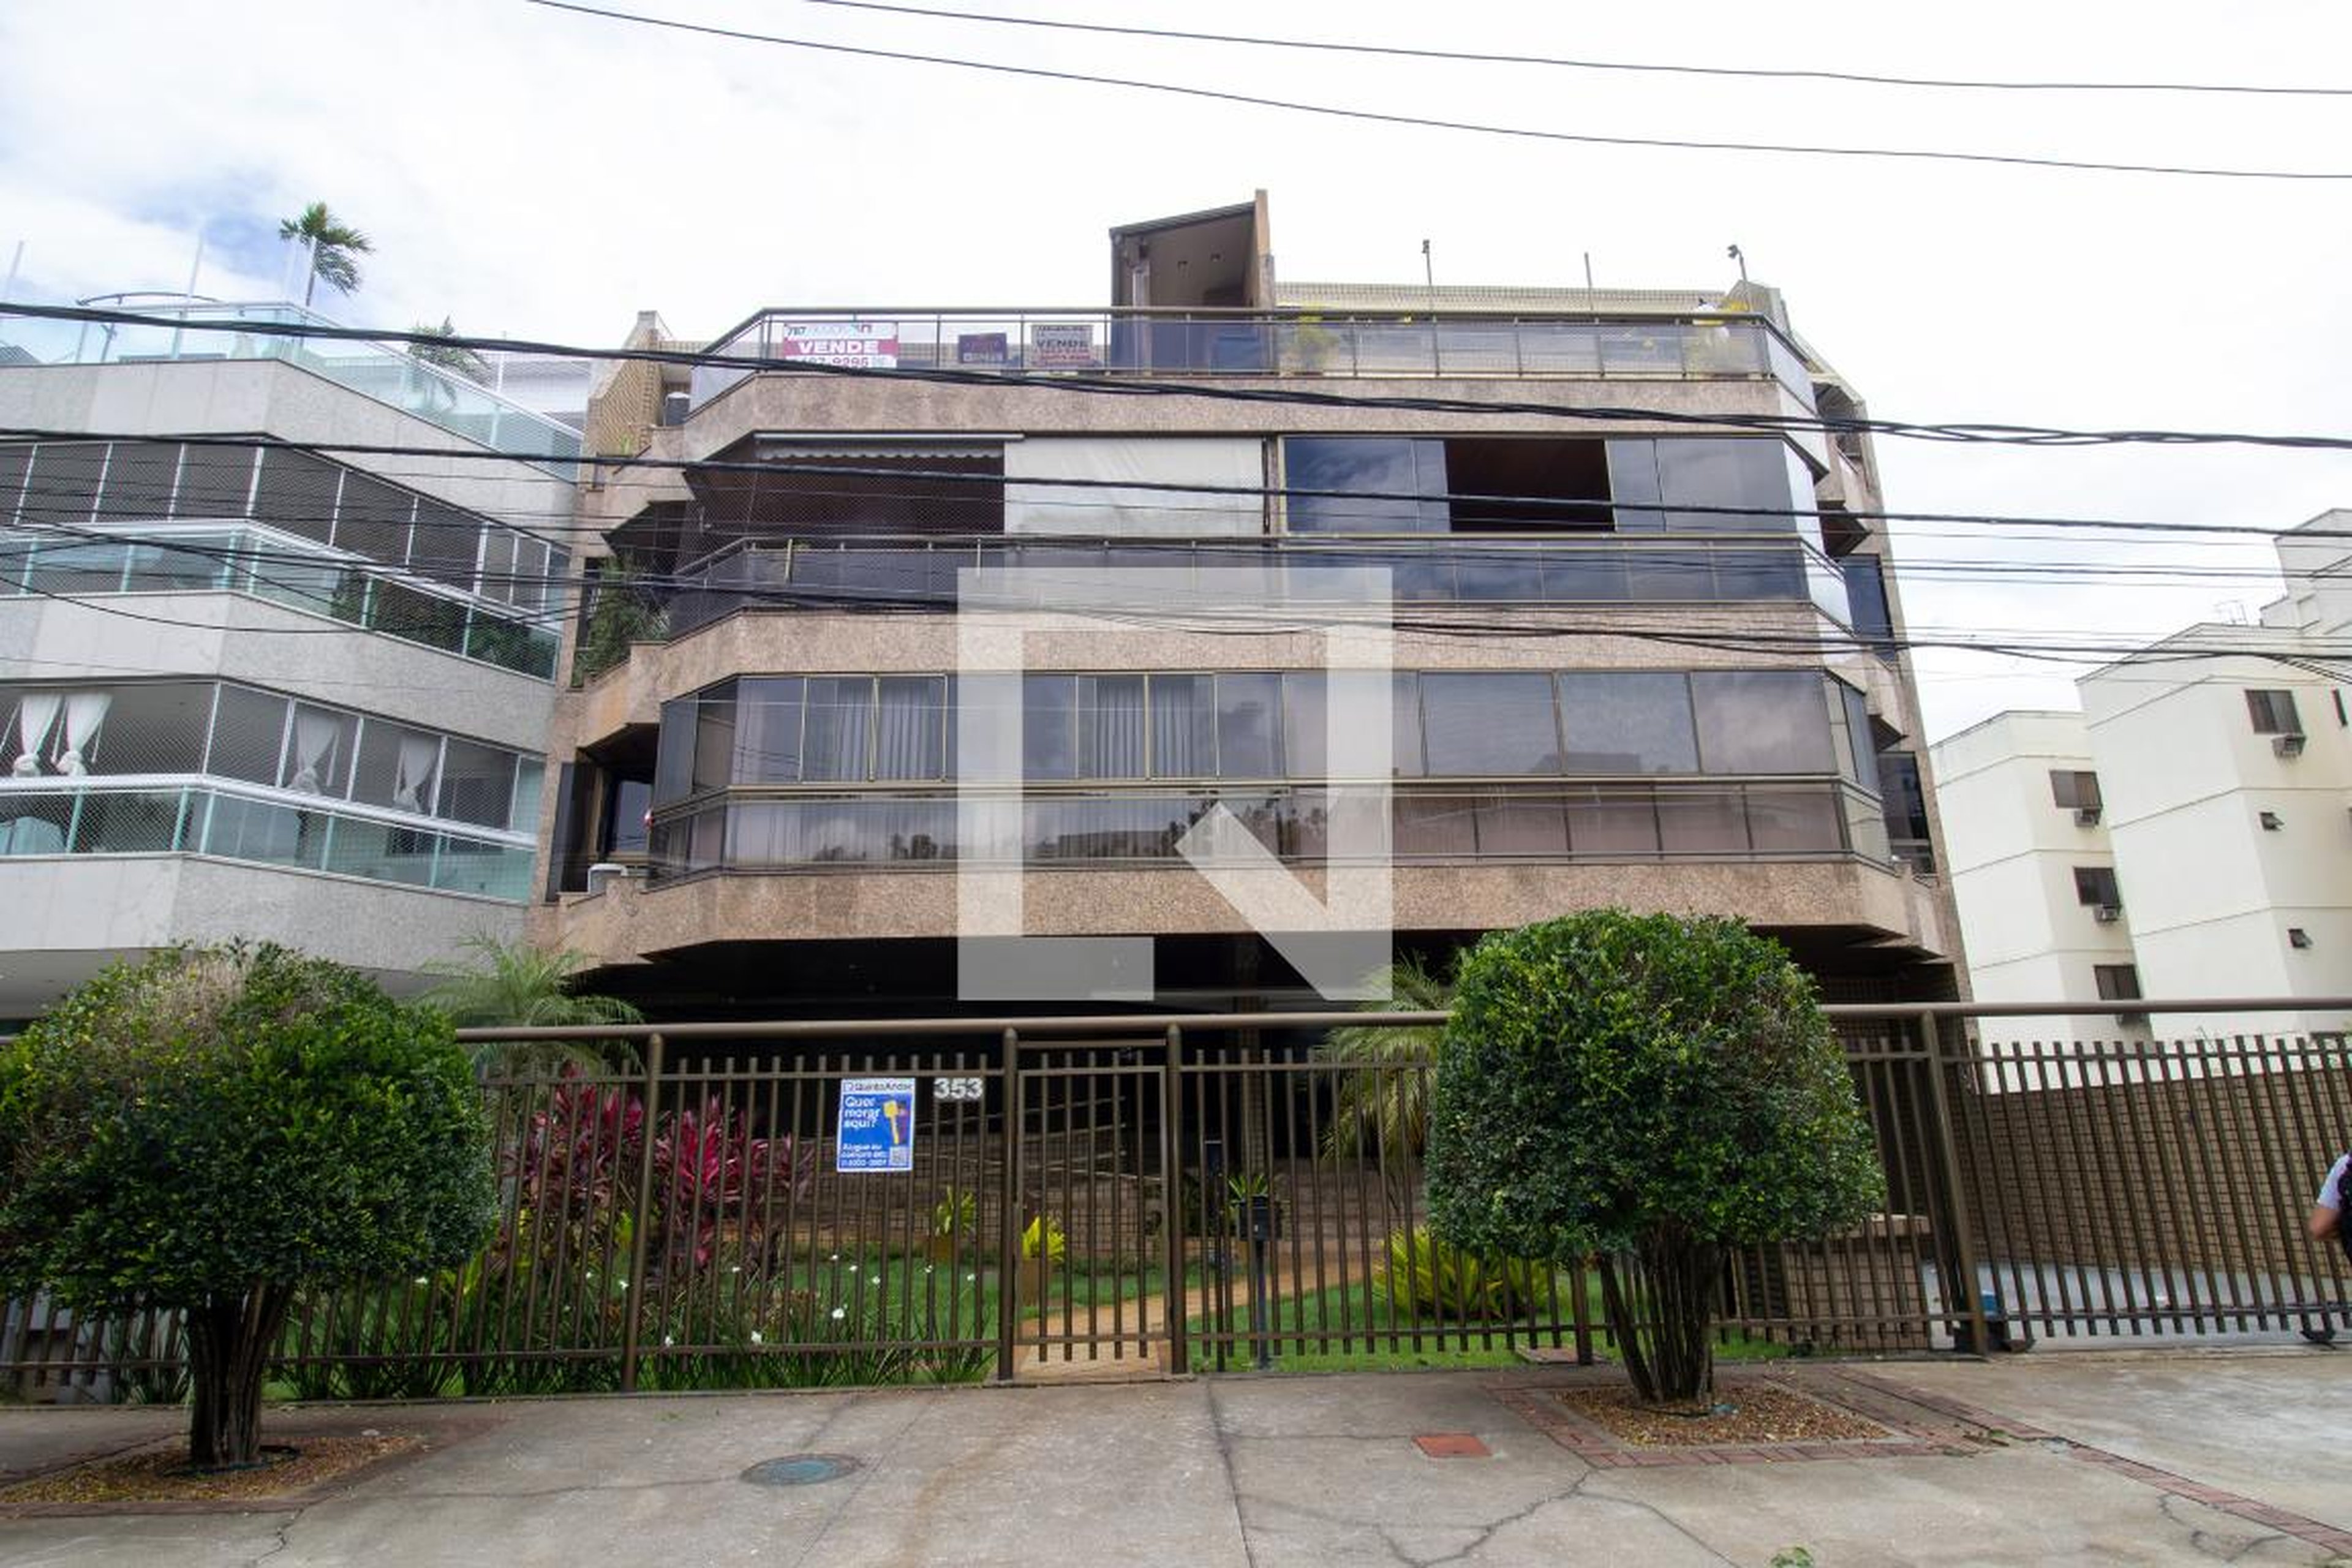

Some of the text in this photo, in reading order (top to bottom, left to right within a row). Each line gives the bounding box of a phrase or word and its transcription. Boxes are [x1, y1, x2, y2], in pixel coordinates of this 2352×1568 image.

[797, 340, 879, 354] VENDE
[934, 1078, 983, 1099] 353
[845, 1096, 875, 1107] Quer
[845, 1108, 881, 1118] morar
[843, 1117, 877, 1129] aqui?
